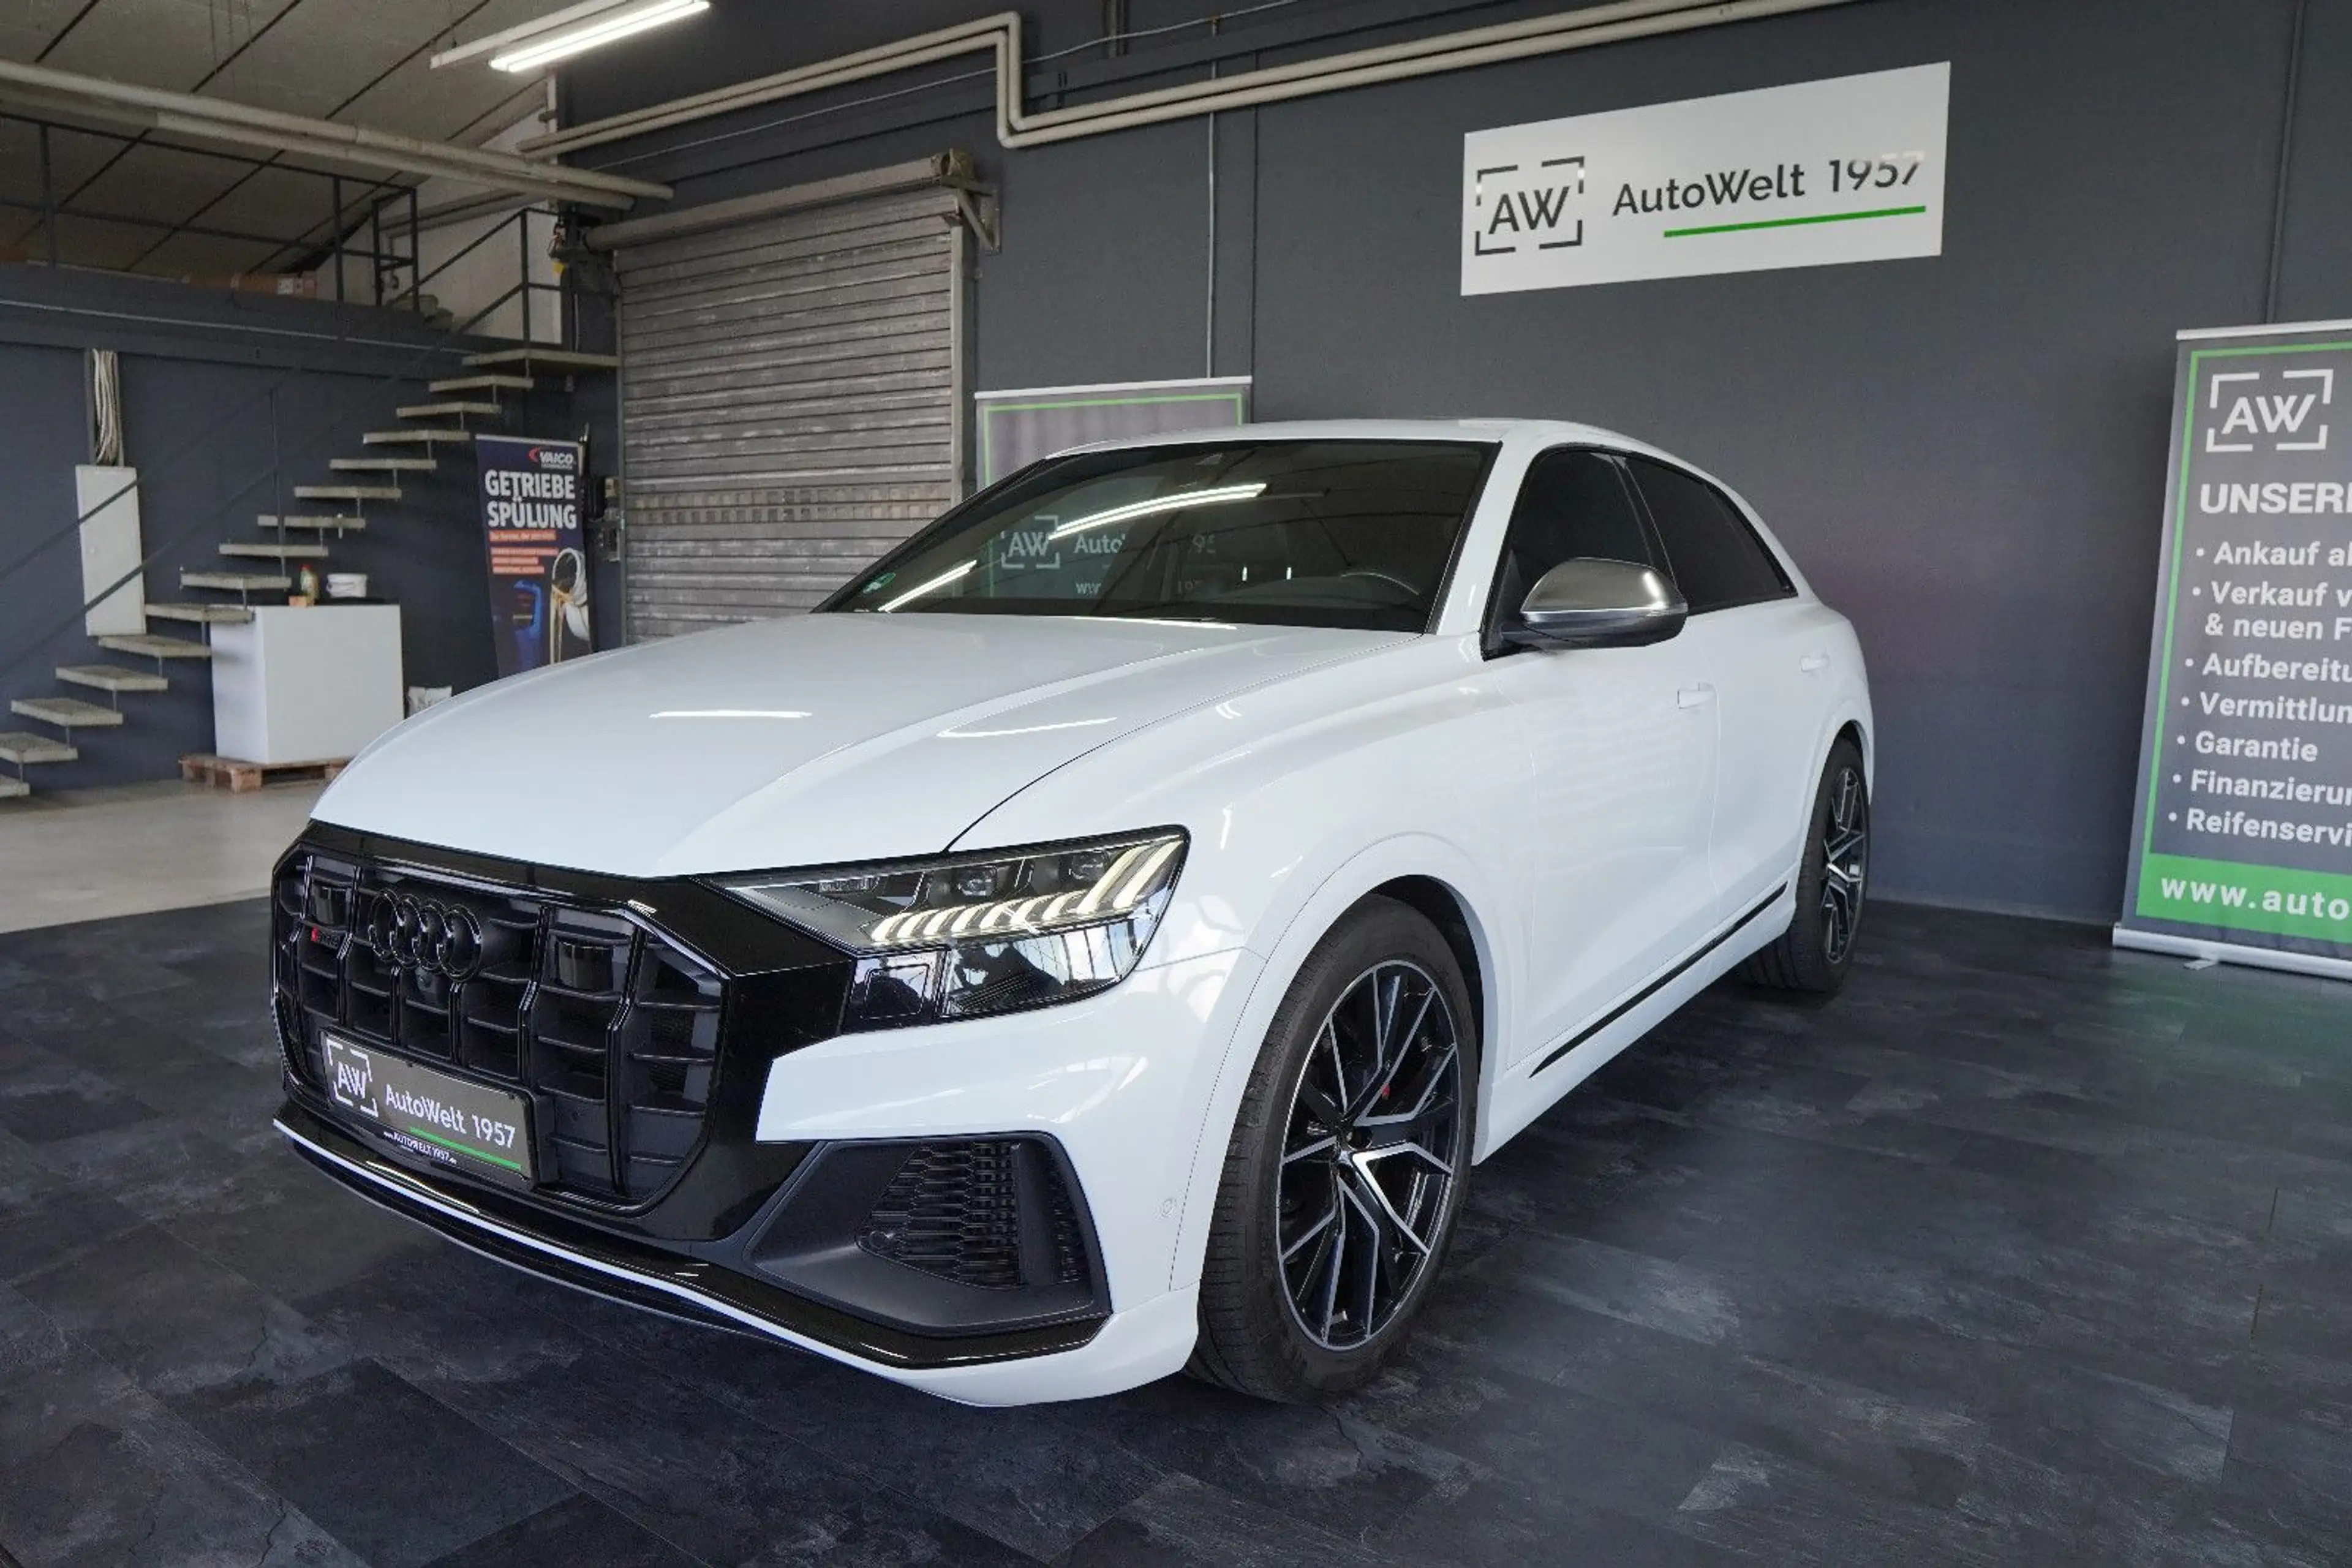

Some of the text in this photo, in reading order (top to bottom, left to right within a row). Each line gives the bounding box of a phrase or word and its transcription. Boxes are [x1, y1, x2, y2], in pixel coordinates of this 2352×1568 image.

[1612, 151, 1926, 216] AutoWelt 1957
[1488, 186, 1570, 235] AW
[2222, 394, 2316, 434] AW
[485, 469, 576, 500] GETRIEBE
[487, 497, 577, 530] SPÜLUNG
[2214, 541, 2321, 566] Ankauf
[2211, 581, 2329, 607] Verkauf
[2204, 613, 2223, 636] &
[2233, 617, 2323, 641] neuen
[2195, 730, 2318, 763] Garantie
[2162, 878, 2350, 921] www.auto
[337, 1061, 366, 1098] AW
[385, 1084, 516, 1148] AutoWelt 1957
